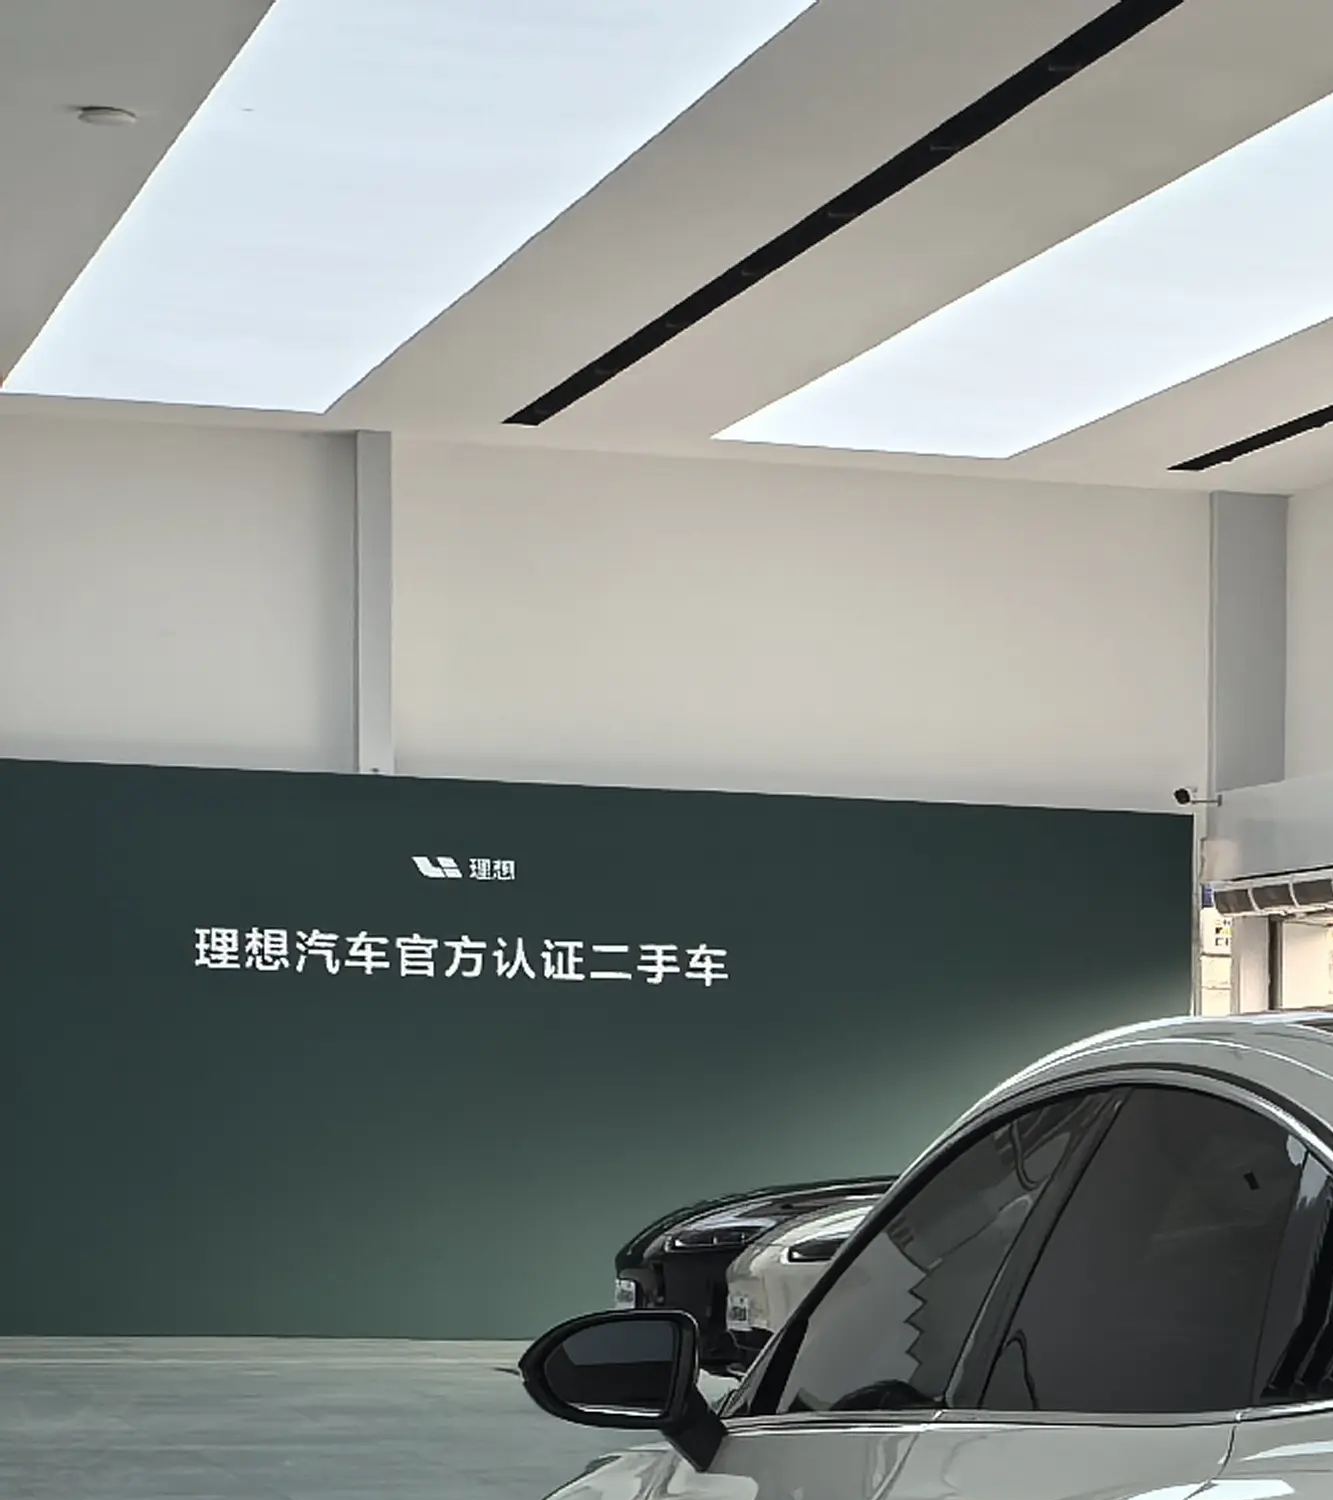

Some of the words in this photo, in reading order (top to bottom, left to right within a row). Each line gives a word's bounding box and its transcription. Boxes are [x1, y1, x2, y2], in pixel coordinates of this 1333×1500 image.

[469, 857, 516, 881] 理想
[194, 926, 729, 988] 理想汽车官方认证二手车
